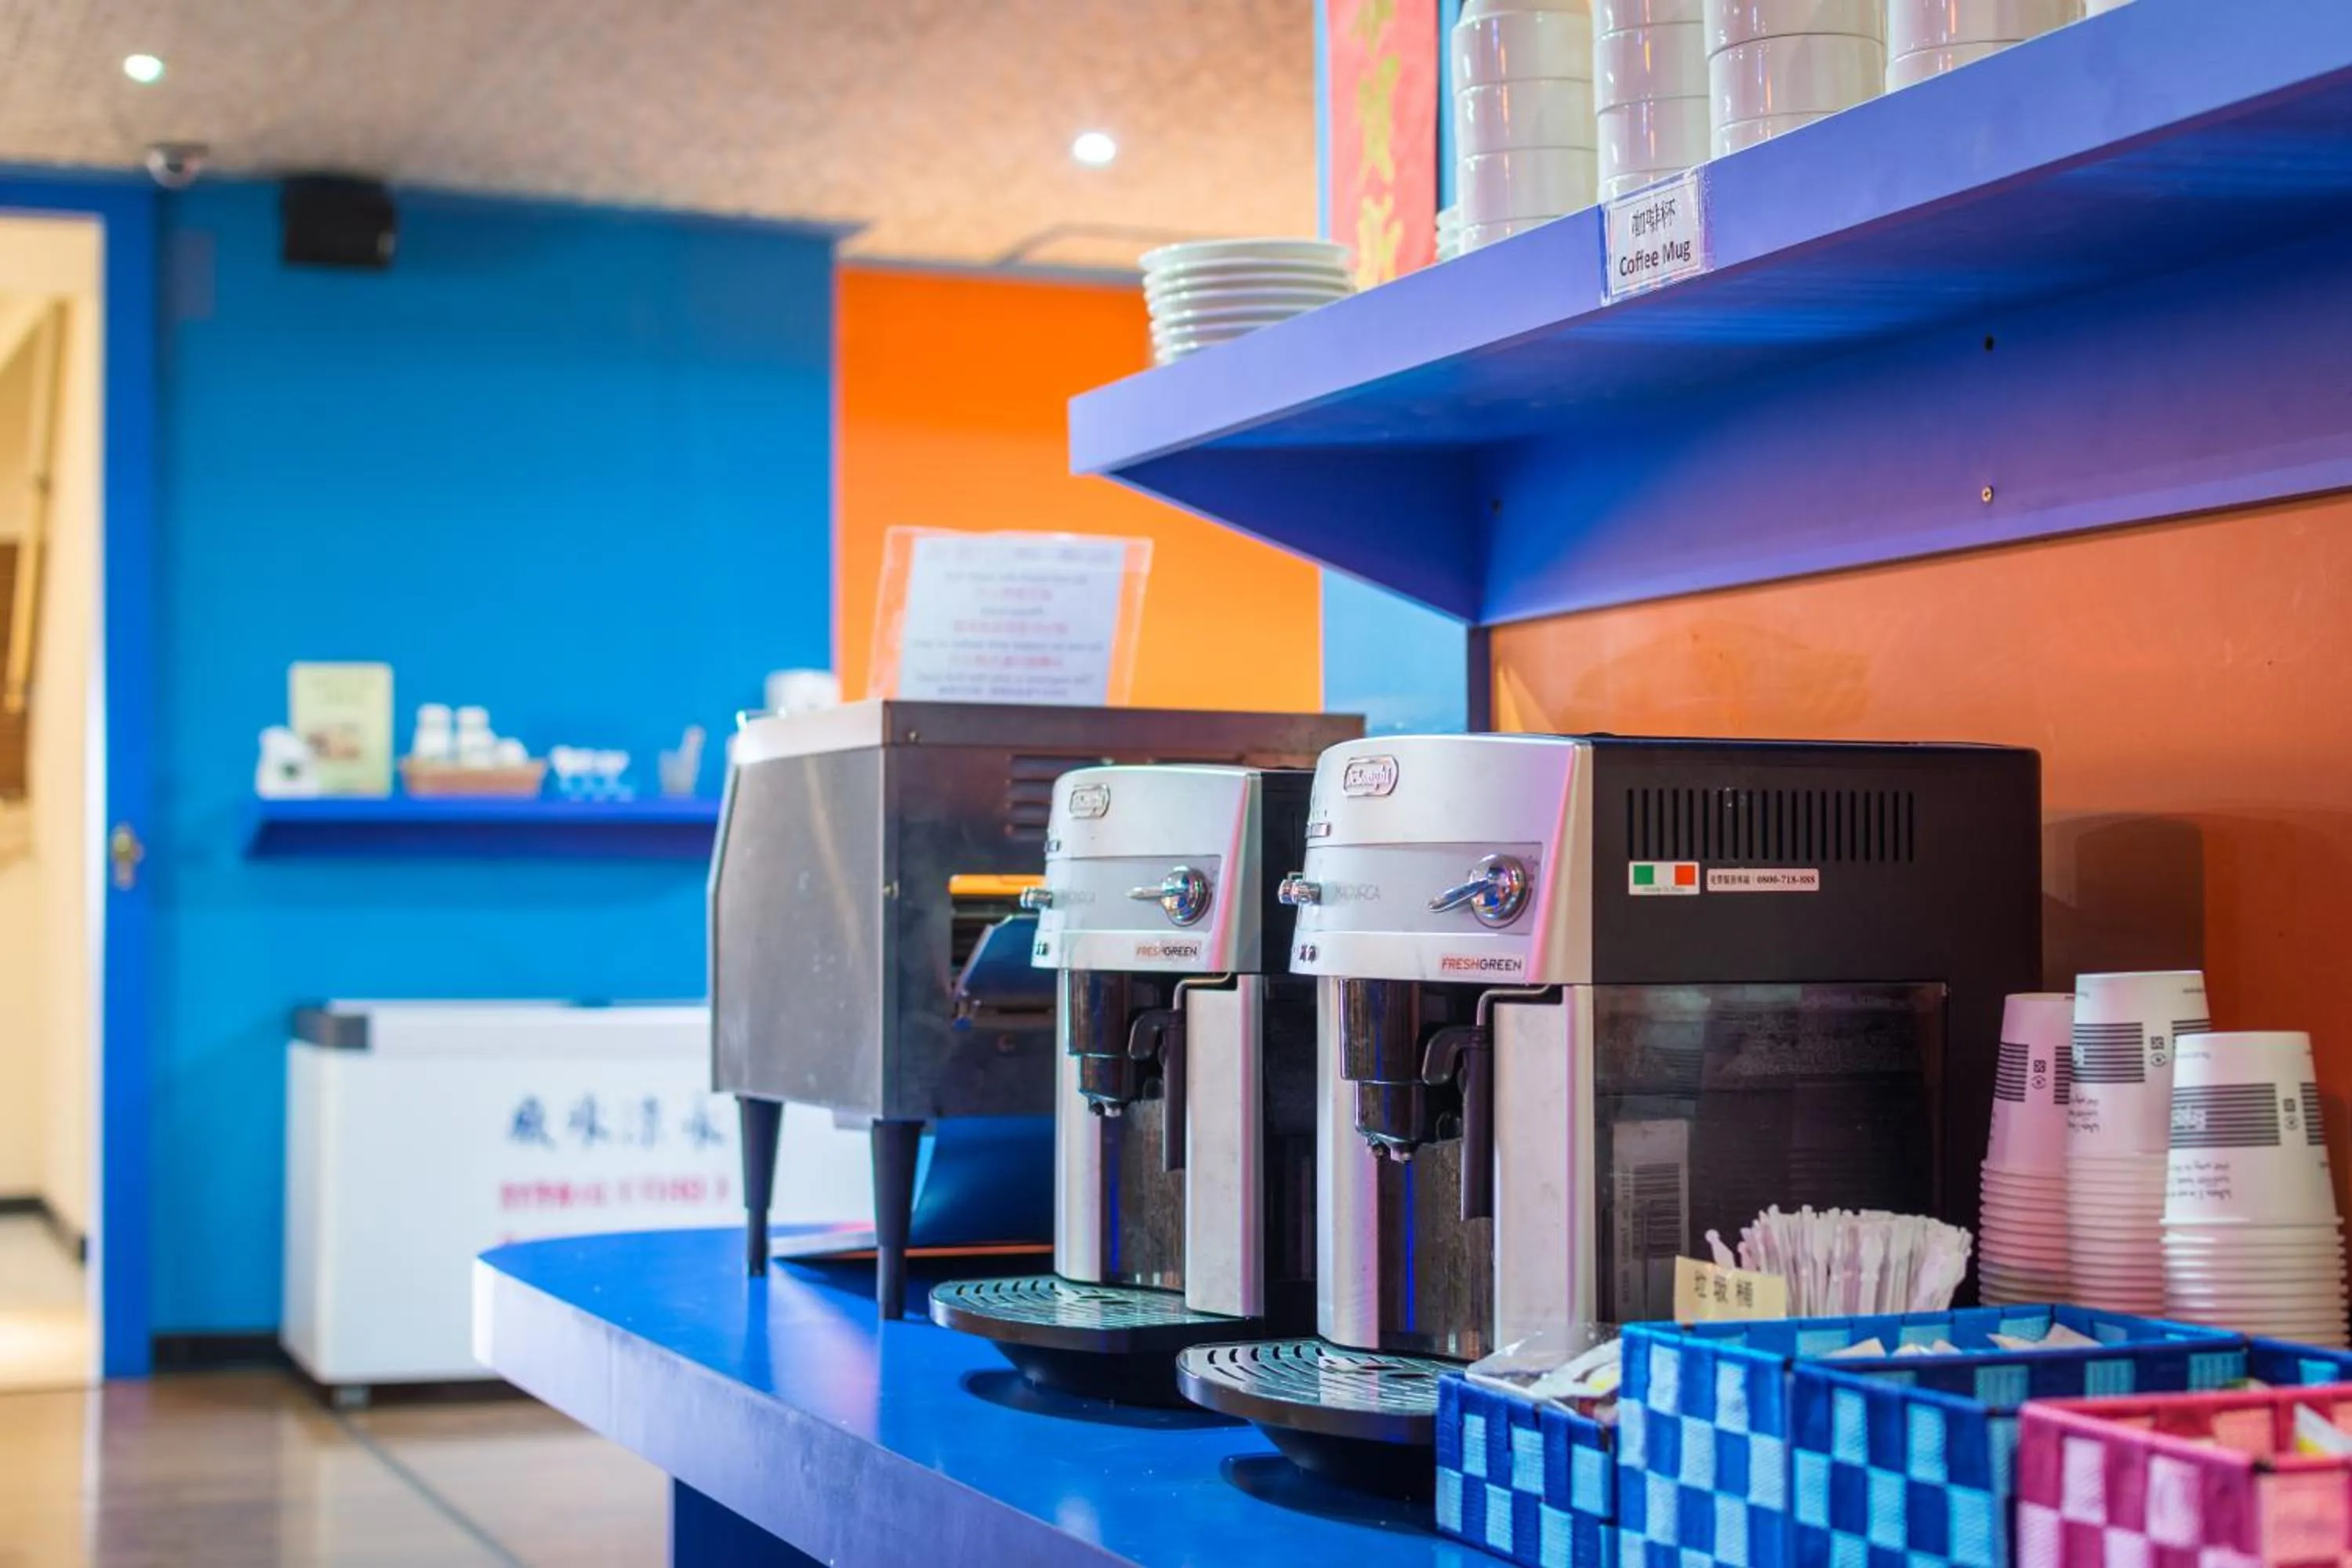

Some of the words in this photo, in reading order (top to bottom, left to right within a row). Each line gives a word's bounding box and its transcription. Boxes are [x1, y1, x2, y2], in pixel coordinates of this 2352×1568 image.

[1632, 198, 1676, 237] 咖啡杯
[1619, 249, 1659, 276] Coffee
[1662, 240, 1691, 262] Mug
[1442, 958, 1523, 971] FRESHGREEN
